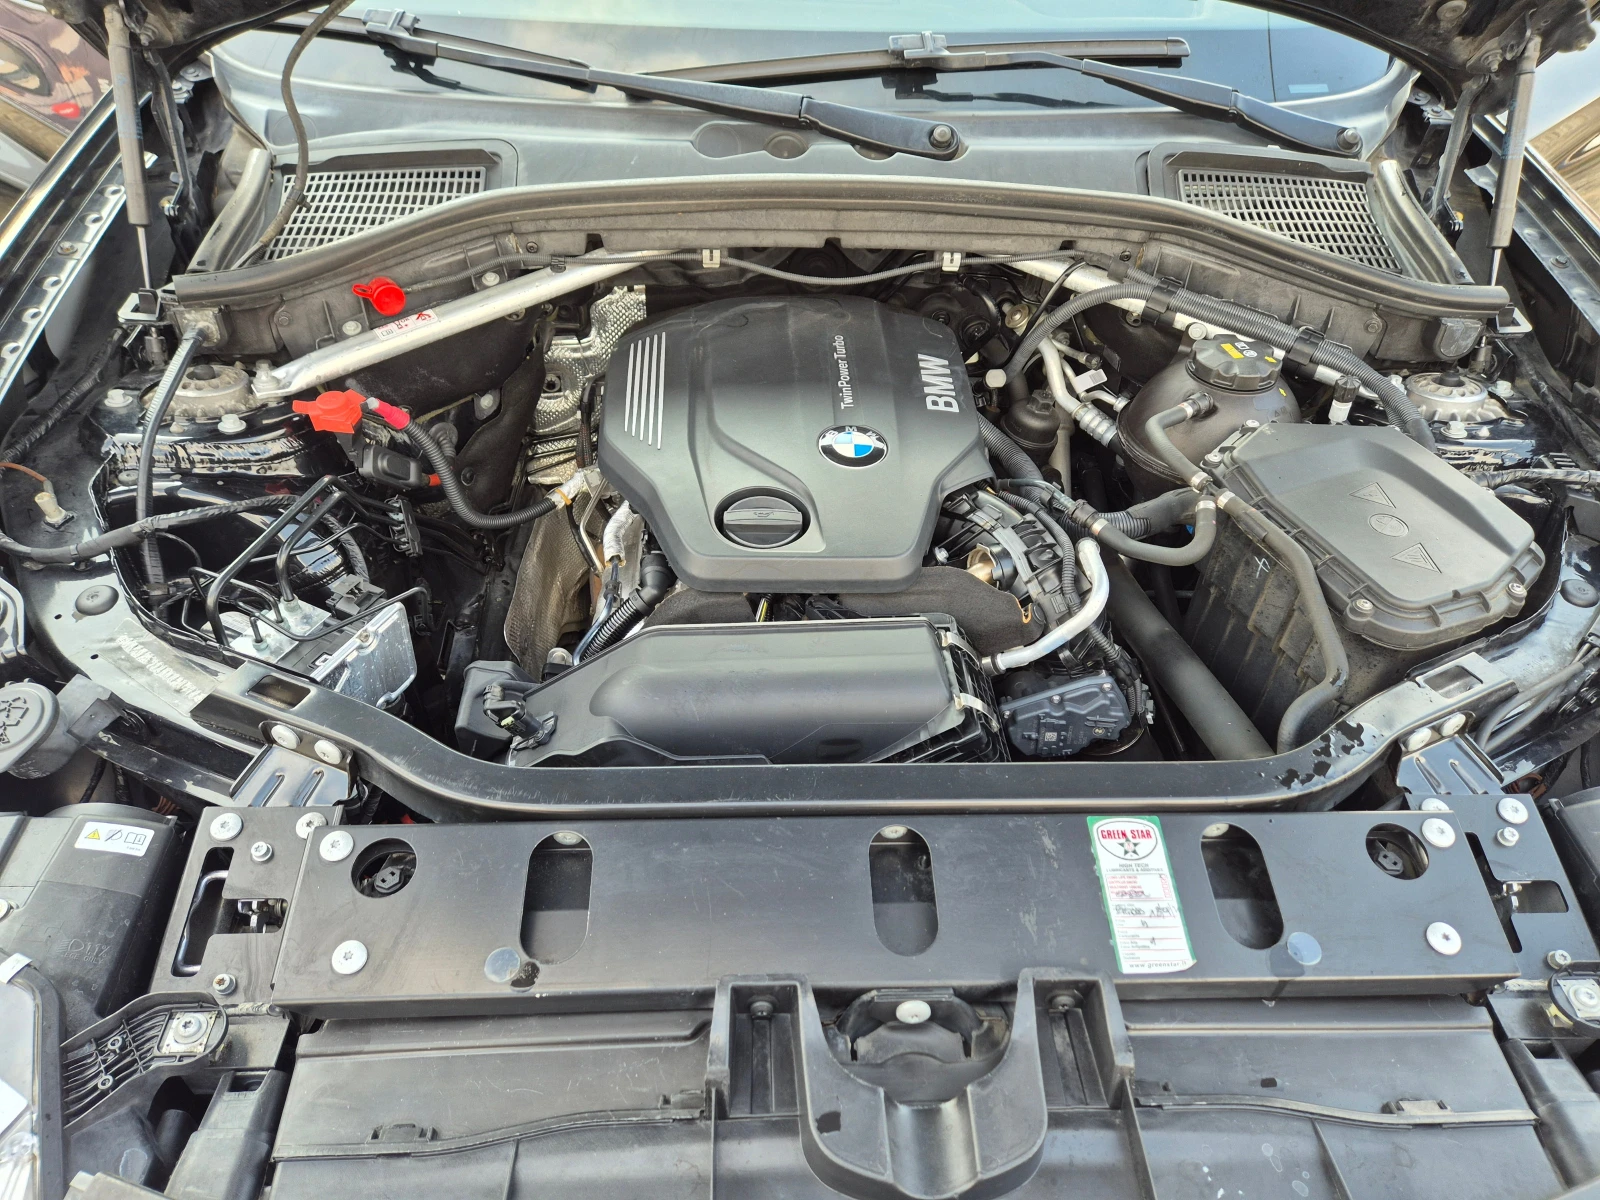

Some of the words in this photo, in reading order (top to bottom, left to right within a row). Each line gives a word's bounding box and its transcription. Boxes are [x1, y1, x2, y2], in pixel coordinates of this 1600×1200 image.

[832, 334, 847, 360] Turbo
[838, 360, 854, 409] TwinPower
[917, 353, 960, 413] BMW
[1100, 829, 1127, 839] GREEN
[1130, 829, 1152, 839] STAR
